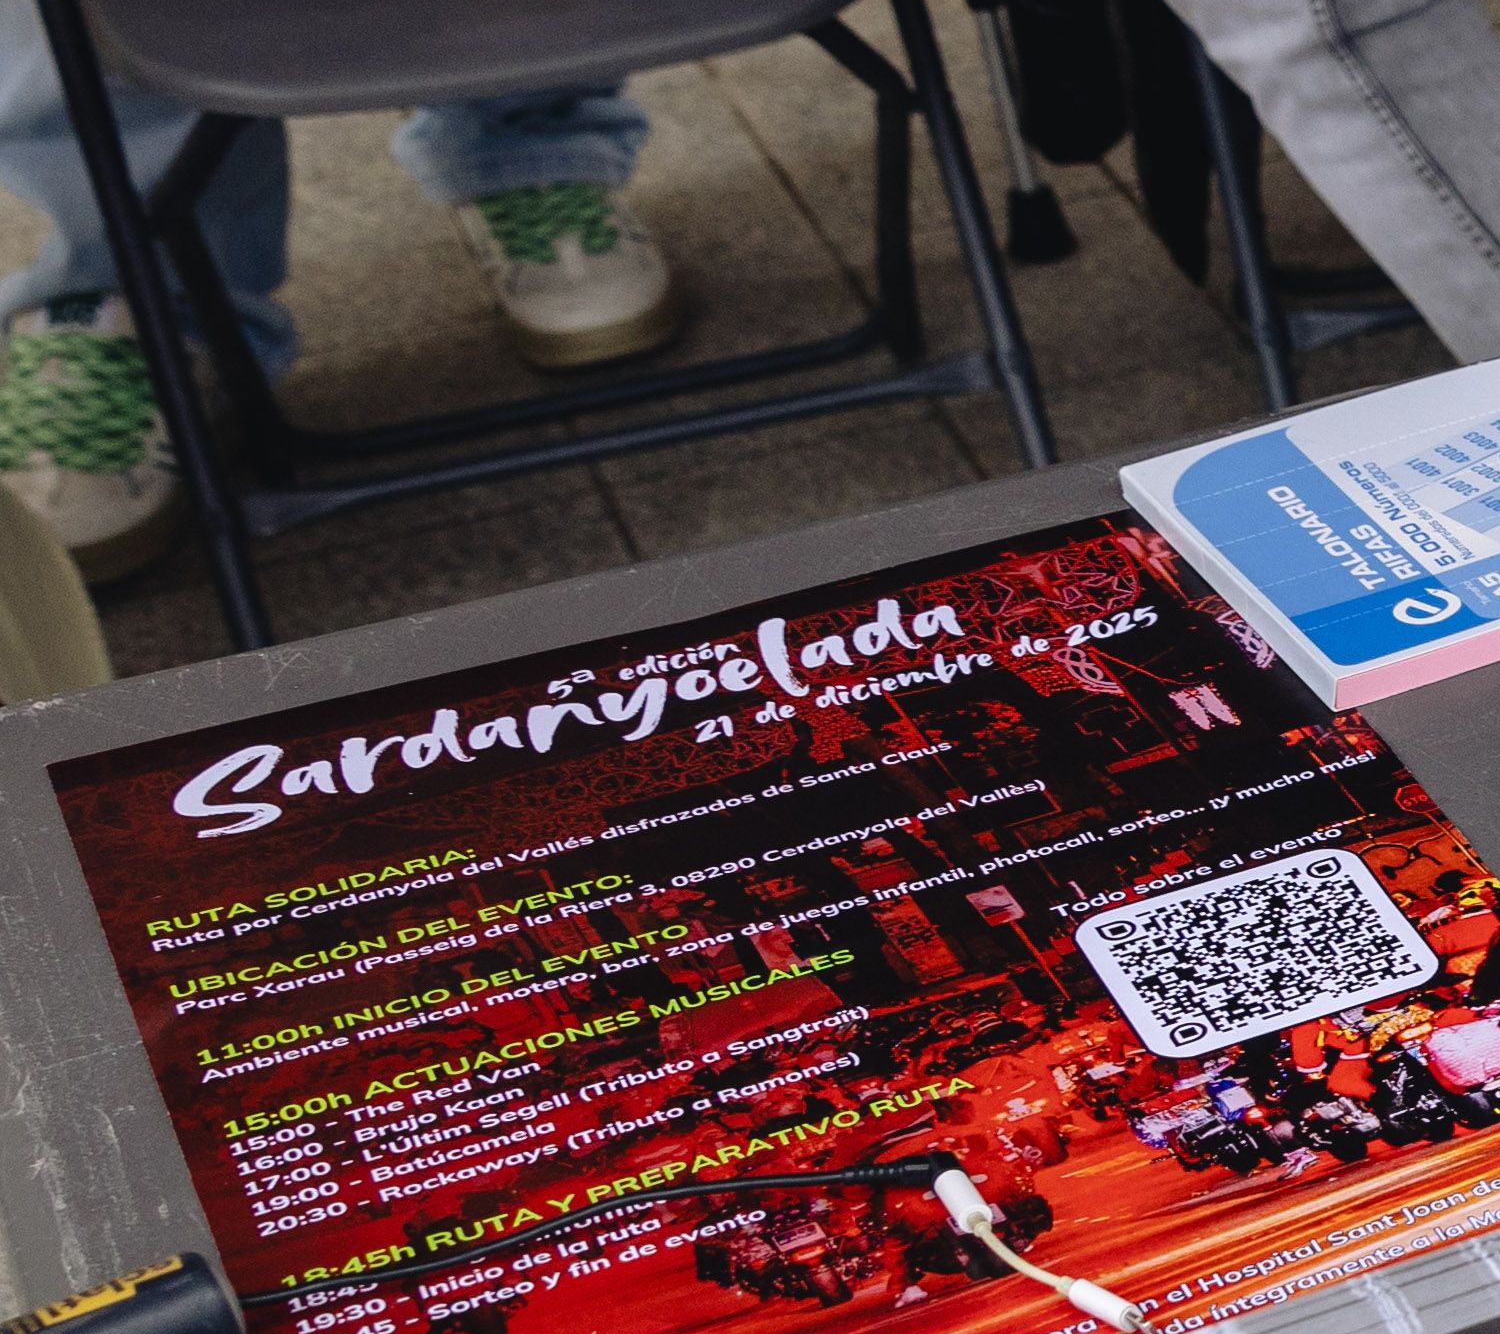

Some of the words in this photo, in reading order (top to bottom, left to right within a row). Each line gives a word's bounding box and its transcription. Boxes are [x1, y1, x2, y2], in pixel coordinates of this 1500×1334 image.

[1338, 460, 1416, 522] Números
[1440, 477, 1480, 497] 3001
[1267, 485, 1386, 590] TALONARIO
[1349, 524, 1421, 580] RIFAS
[1399, 522, 1457, 567] 5.000
[547, 666, 596, 698] 5ª
[619, 641, 742, 682] edición
[694, 715, 734, 743] 21
[755, 701, 796, 724] de
[814, 653, 996, 710] diciembre
[1011, 635, 1050, 658] de
[1064, 605, 1158, 647] 2025
[146, 902, 255, 936] RUTA
[264, 849, 476, 909] SOLIDARIA:
[151, 928, 225, 952] Ruta
[233, 914, 282, 936] por
[290, 872, 454, 919] Cerdanyola
[462, 856, 504, 876] del
[507, 835, 594, 862] Vallés
[600, 794, 756, 840] disfrazados
[761, 784, 794, 798] de
[799, 762, 877, 788] Santa
[881, 742, 952, 765] Claus
[1049, 891, 1127, 917] Todo
[1133, 866, 1213, 895] sobre
[1219, 853, 1244, 869] el
[1250, 823, 1342, 860] evento
[170, 935, 387, 998] UBICACIÓN
[397, 917, 468, 944] DEL
[478, 874, 633, 922] EVENTO:
[202, 1037, 350, 1083] Ambiente
[357, 1001, 479, 1041] musical,
[485, 972, 597, 1006] motero,
[601, 954, 660, 974] bar,
[665, 932, 734, 957] zona
[741, 921, 775, 936] de
[779, 896, 870, 929] juegos
[872, 867, 975, 901] infantil,
[979, 831, 1104, 875] photocall,
[1107, 807, 1205, 836] sorteo...
[1208, 795, 1230, 810] ¡y
[1235, 770, 1315, 800] mucho
[1319, 749, 1377, 774] más!
[197, 1024, 323, 1066] 11:00h
[333, 988, 449, 1030] INICIO
[461, 968, 533, 995] DEL
[541, 924, 688, 973] EVENTO
[1165, 1282, 1193, 1305] el
[1196, 1239, 1323, 1295] Hospital
[1328, 1213, 1396, 1250] Sant
[1403, 1191, 1467, 1229] Joan
